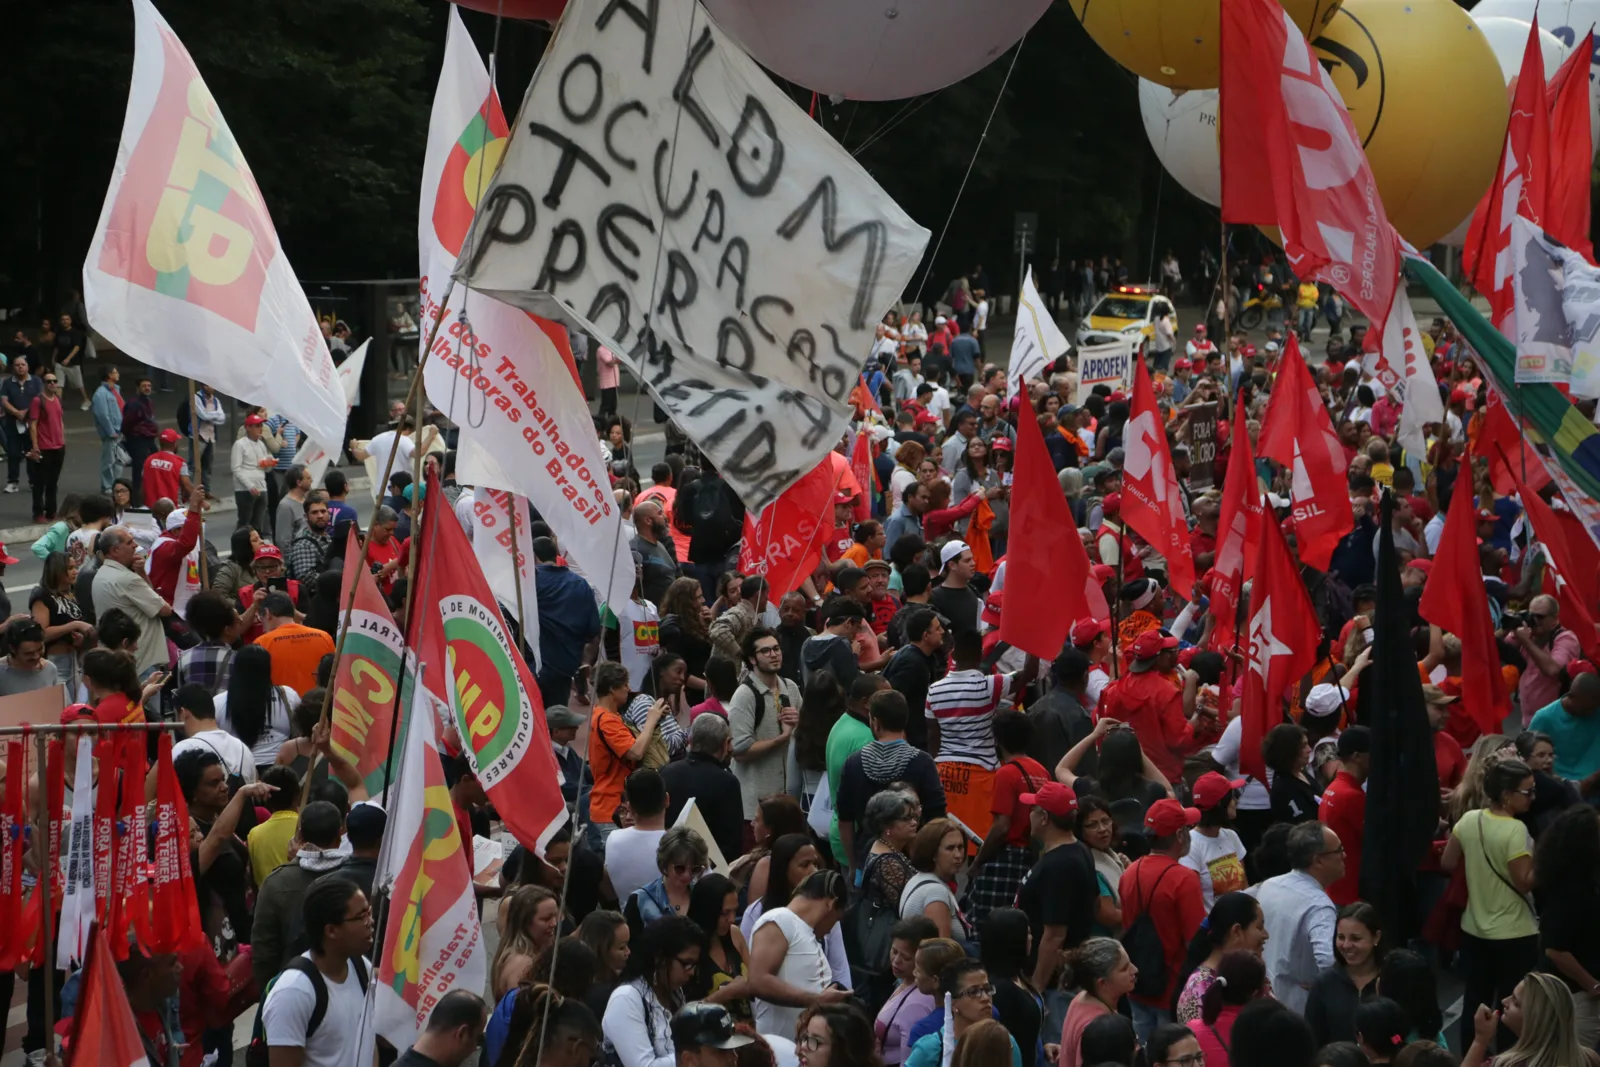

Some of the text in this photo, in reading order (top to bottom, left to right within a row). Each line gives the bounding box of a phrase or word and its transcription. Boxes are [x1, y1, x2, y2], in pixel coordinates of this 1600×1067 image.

[1082, 355, 1128, 379] APROFEM
[448, 321, 492, 358] dos
[495, 355, 612, 517] Trabalhadores
[473, 500, 496, 528] do
[522, 426, 546, 456] do
[544, 457, 602, 525] Brasil
[1249, 625, 1271, 667] PT
[450, 601, 463, 613] DE
[486, 701, 530, 783] POPULARES
[97, 818, 110, 897] FORA TEMER
[135, 805, 147, 863] DIRETAS
[159, 804, 170, 883] FORA TEMER
